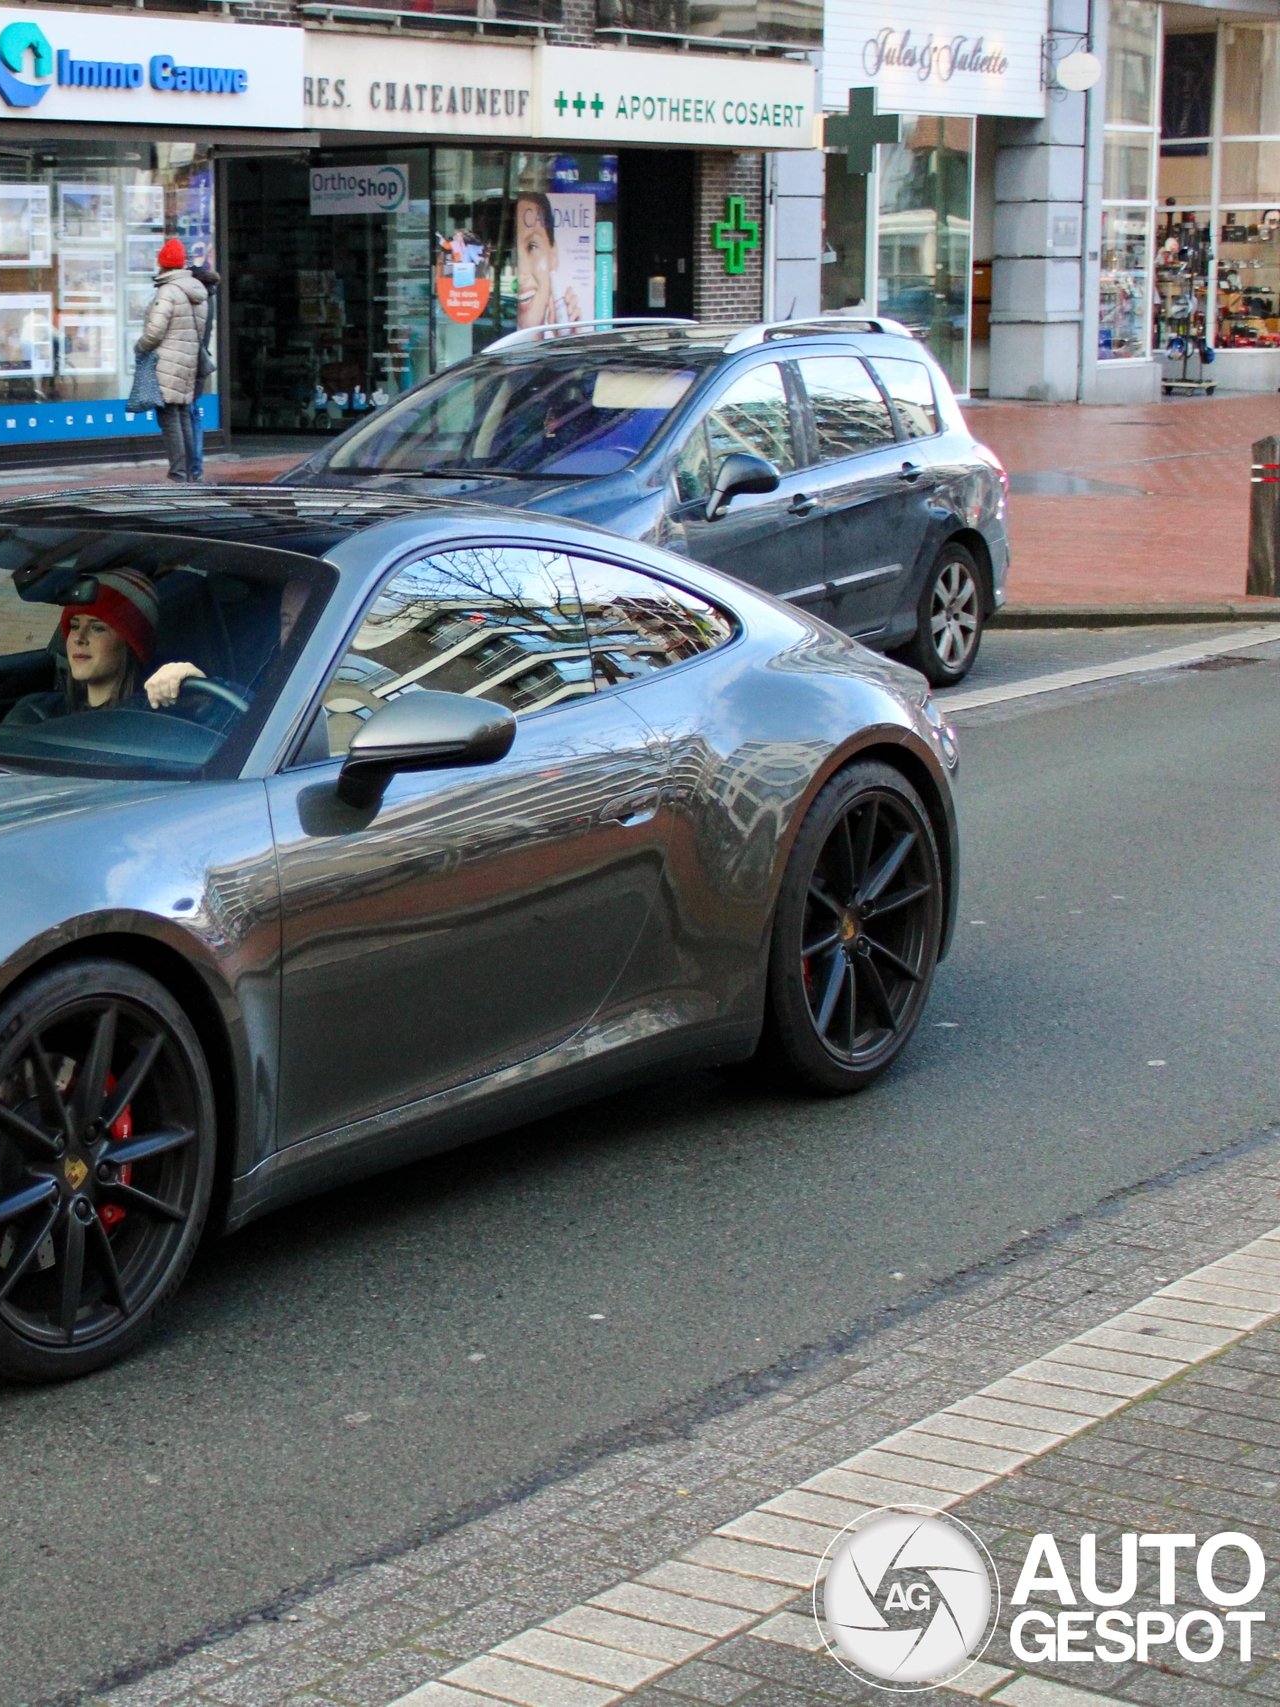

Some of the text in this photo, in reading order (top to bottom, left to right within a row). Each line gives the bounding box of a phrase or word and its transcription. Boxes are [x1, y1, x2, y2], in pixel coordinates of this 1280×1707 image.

[57, 49, 248, 94] Immo Cauwe
[863, 27, 917, 76] Jules
[937, 35, 1008, 82] Juliette
[303, 76, 530, 118] RES. CHATEAUNEUF
[615, 95, 805, 128] APOTHEEK COSAERT
